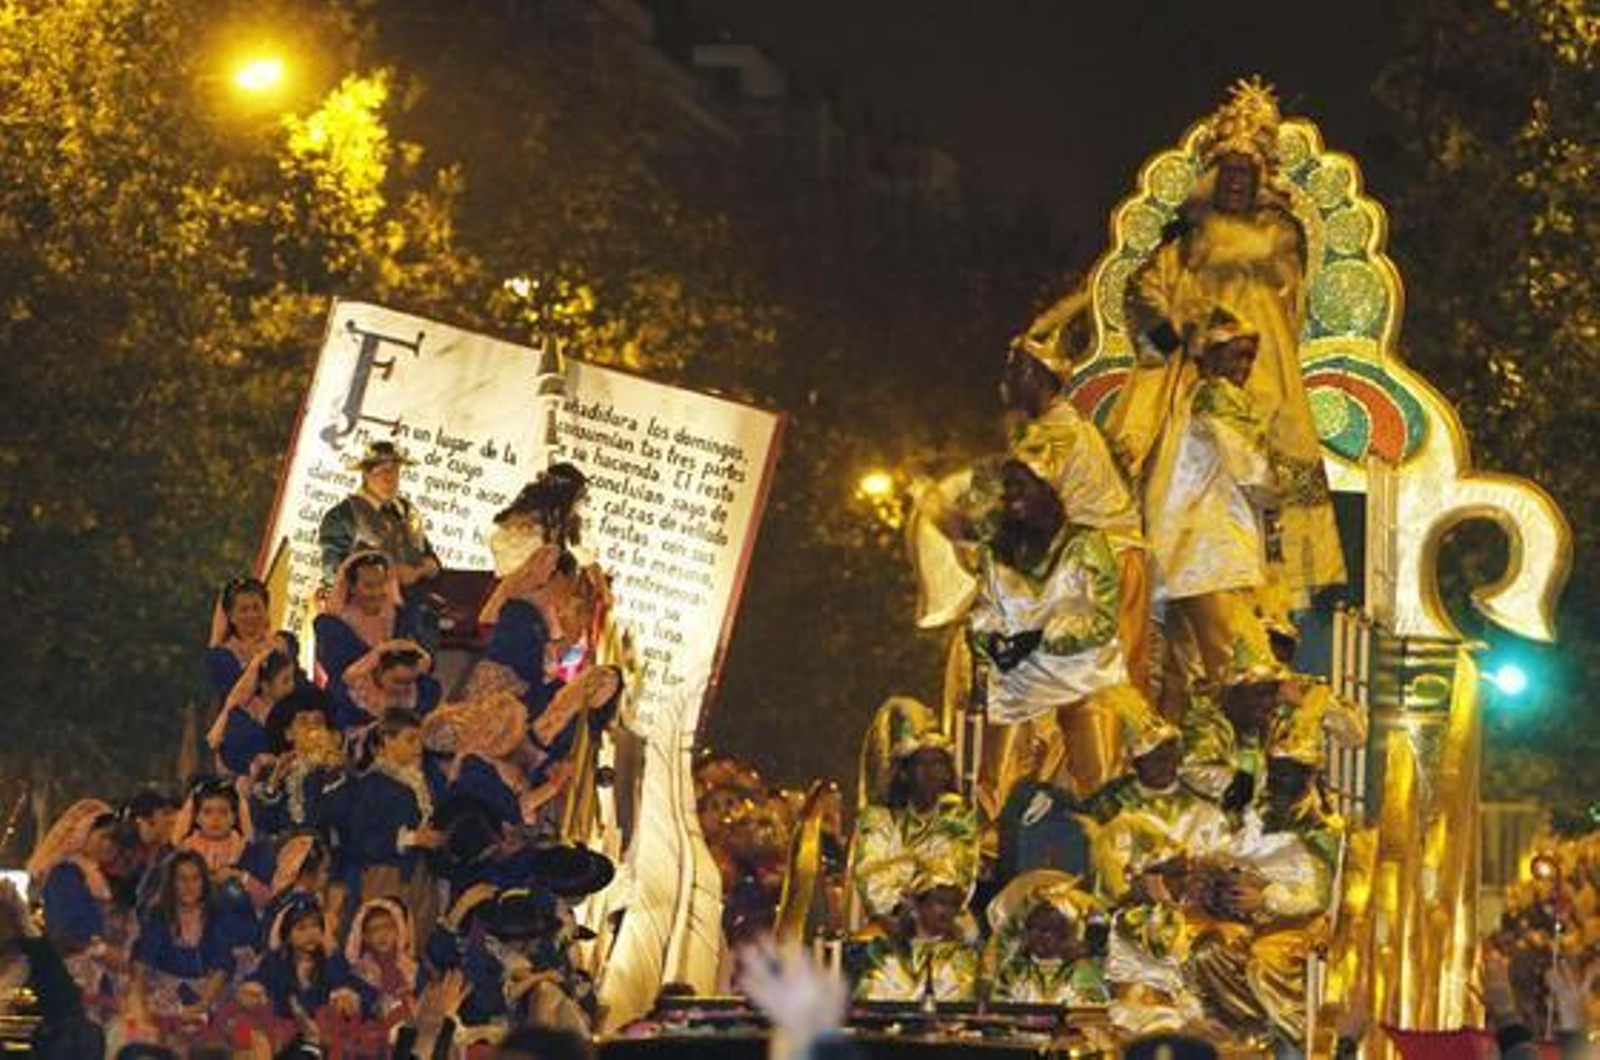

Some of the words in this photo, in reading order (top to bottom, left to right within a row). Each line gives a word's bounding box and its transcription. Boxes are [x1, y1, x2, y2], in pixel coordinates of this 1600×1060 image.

[647, 416, 669, 441] los
[424, 447, 443, 466] de
[436, 424, 474, 457] lugar
[479, 437, 498, 460] de
[504, 443, 518, 467] la
[667, 445, 697, 470] tres
[603, 499, 655, 525] calzas
[710, 504, 729, 524] de
